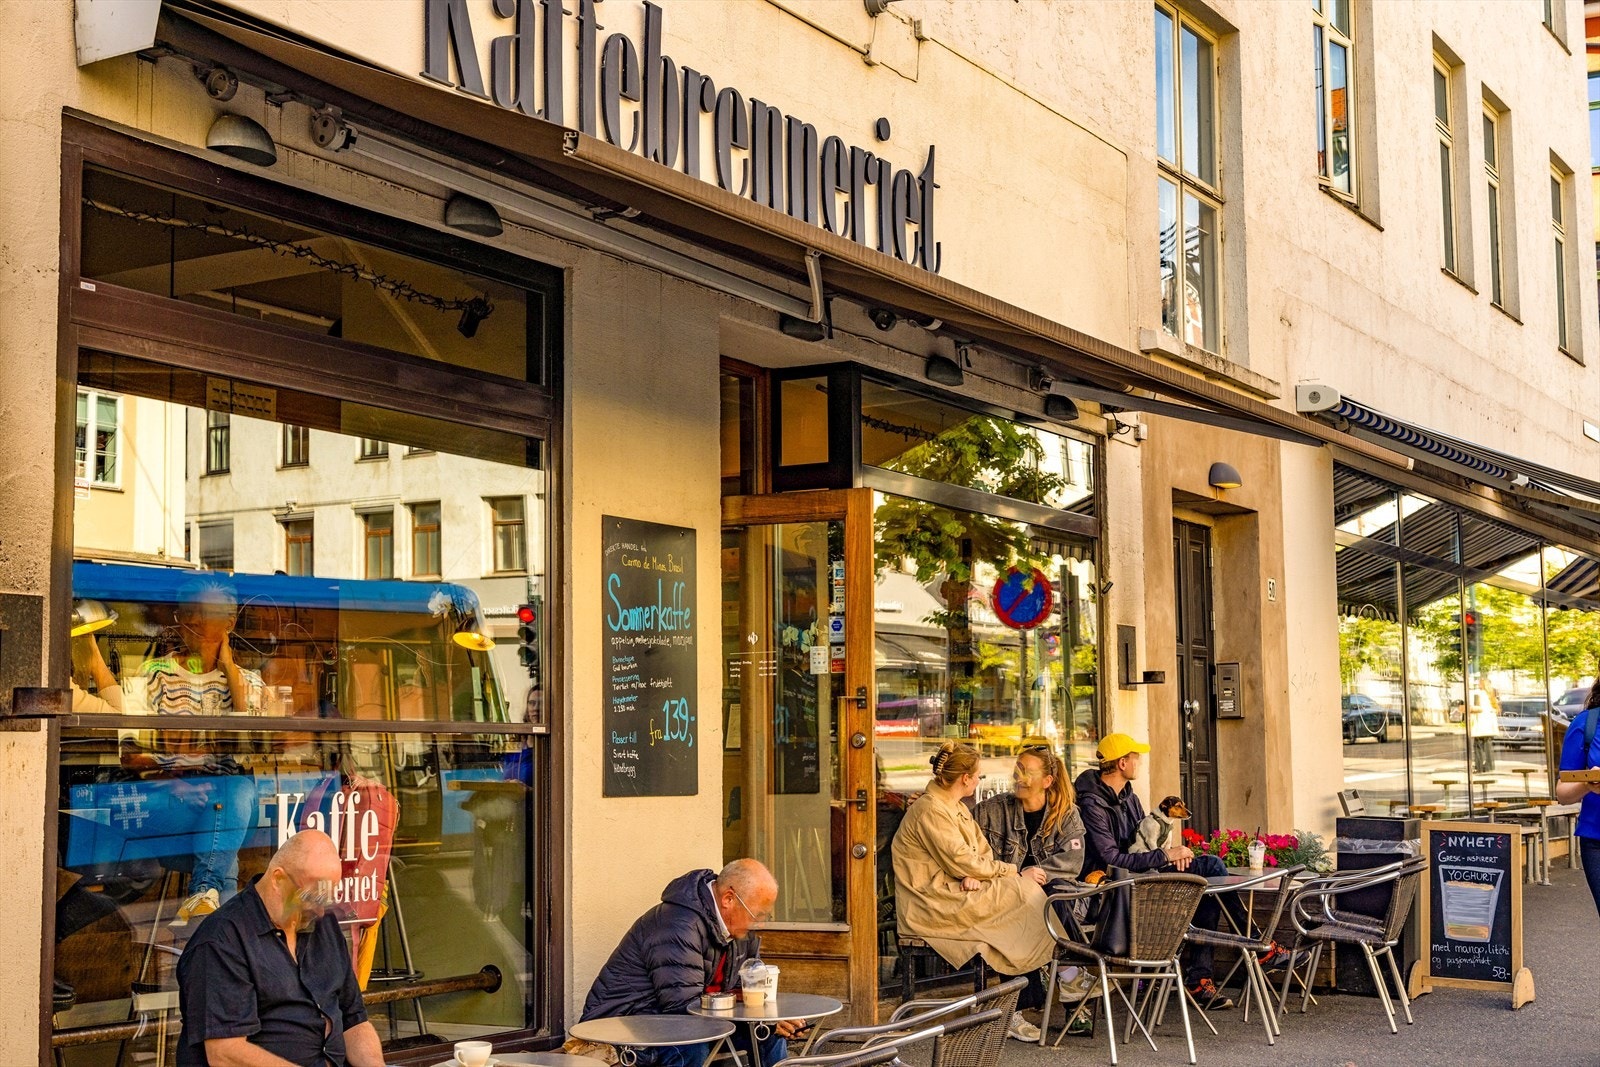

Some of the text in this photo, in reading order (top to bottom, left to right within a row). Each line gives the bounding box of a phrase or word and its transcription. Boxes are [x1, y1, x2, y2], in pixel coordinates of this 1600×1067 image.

[419, 0, 942, 275] Kaffebrenneriet
[607, 573, 691, 633] Sommerkaffe
[611, 731, 628, 744] Passer
[649, 718, 663, 747] fra
[1448, 836, 1495, 848] NYHET
[1447, 870, 1497, 882] YOGHURT
[1432, 941, 1451, 953] med
[1431, 956, 1442, 969] og
